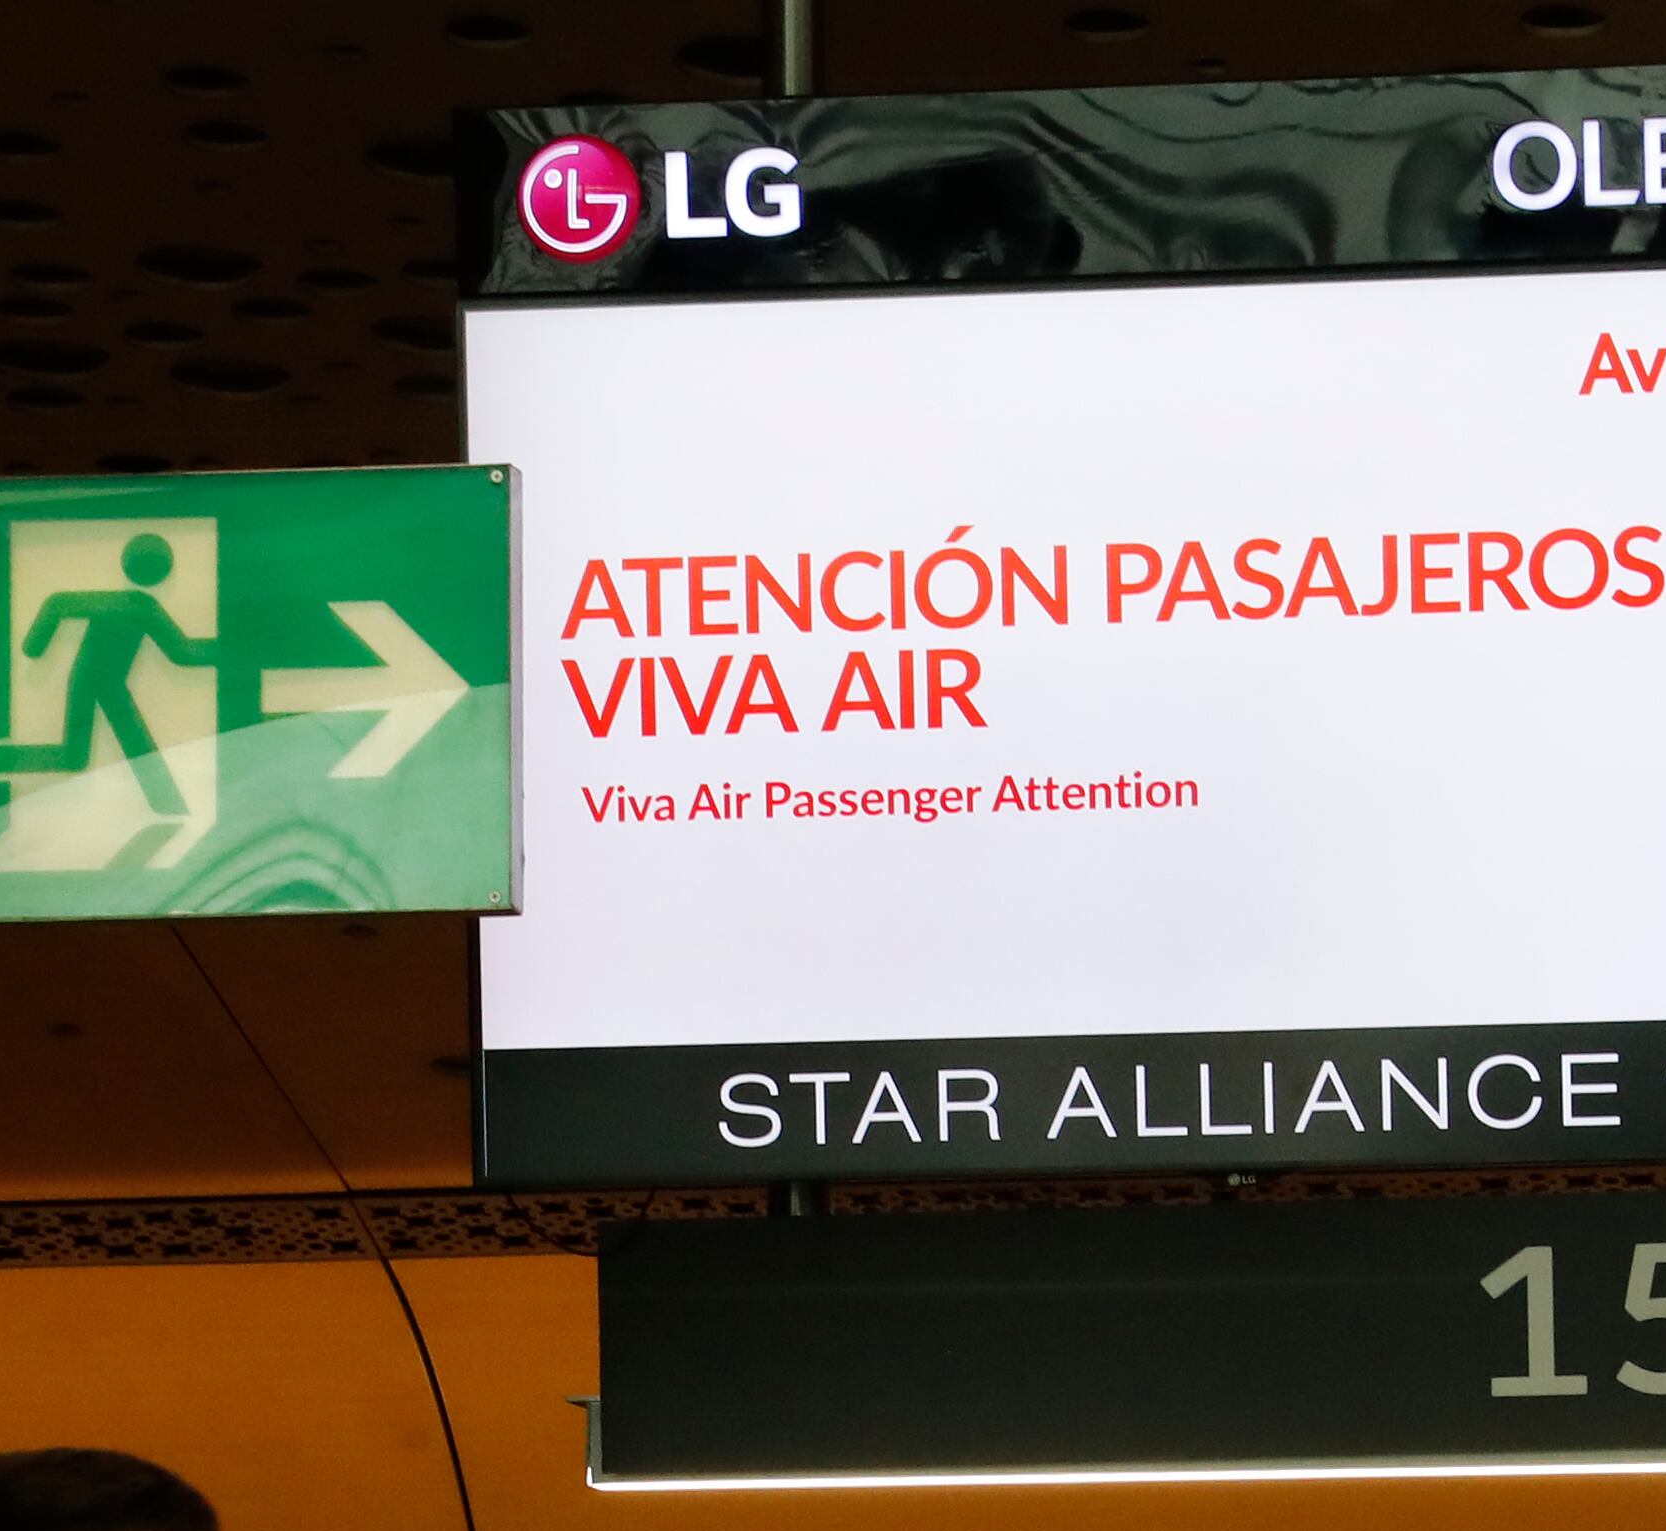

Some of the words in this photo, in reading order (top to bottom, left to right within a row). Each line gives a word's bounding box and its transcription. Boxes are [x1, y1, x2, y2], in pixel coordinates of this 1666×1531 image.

[664, 146, 802, 239] LG
[559, 523, 1070, 642] ATENCIÓN
[1105, 524, 1666, 626] PASAJEROS
[560, 652, 801, 740] VIVA
[820, 647, 990, 734] AIR
[581, 784, 677, 825] Viva
[686, 780, 753, 822] Air
[764, 780, 984, 824] Passenger
[991, 770, 1201, 815] Attention
[717, 1068, 1002, 1149] STAR
[1046, 1051, 1622, 1140] ALLIANCE
[1241, 1175, 1256, 1184] LG
